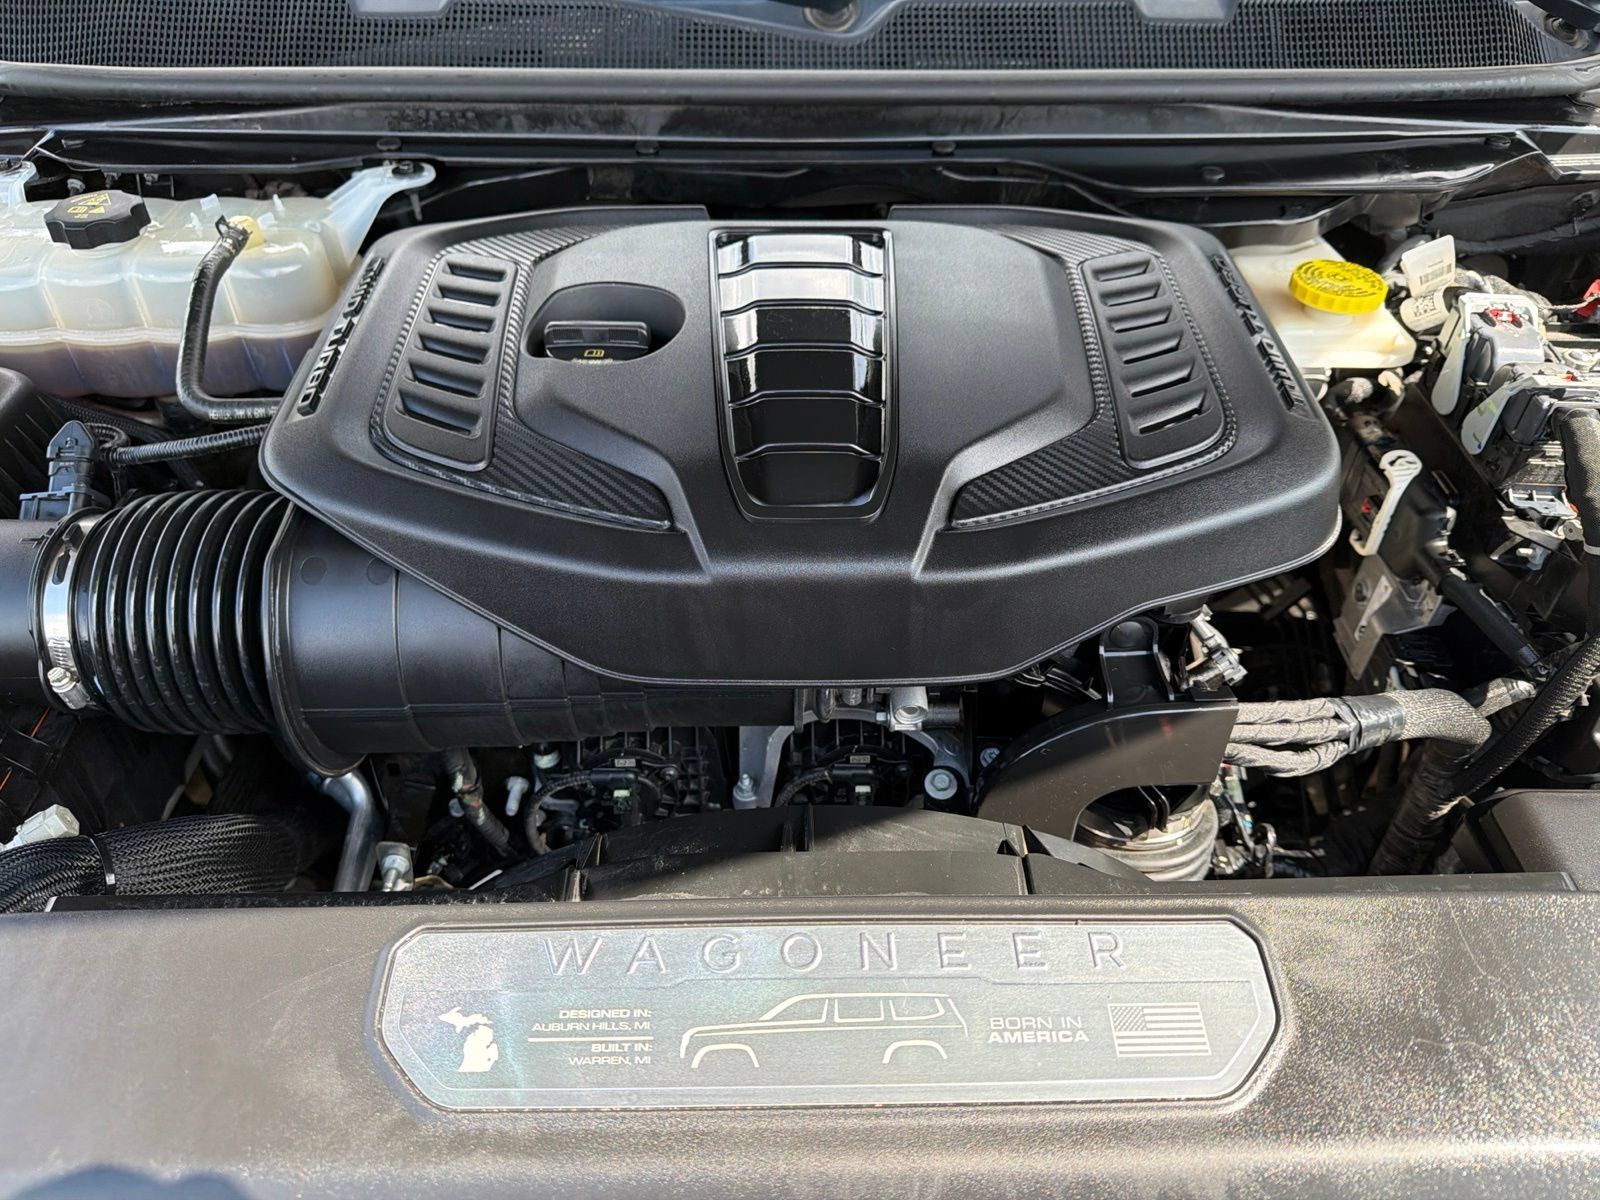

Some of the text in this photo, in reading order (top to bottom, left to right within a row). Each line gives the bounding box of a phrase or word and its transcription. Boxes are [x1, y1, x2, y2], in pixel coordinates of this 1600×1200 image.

[297, 317, 355, 417] TURBO
[543, 930, 1127, 976] WAGONEER
[559, 1009, 653, 1019] DESIGNED IN:
[531, 1021, 651, 1031] AUBURN HILLS, MI
[989, 1016, 1082, 1030] BORN IN
[987, 1030, 1090, 1043] AMERICA
[591, 1042, 653, 1052] BUILT IN:
[568, 1056, 651, 1066] WARREN, MI
